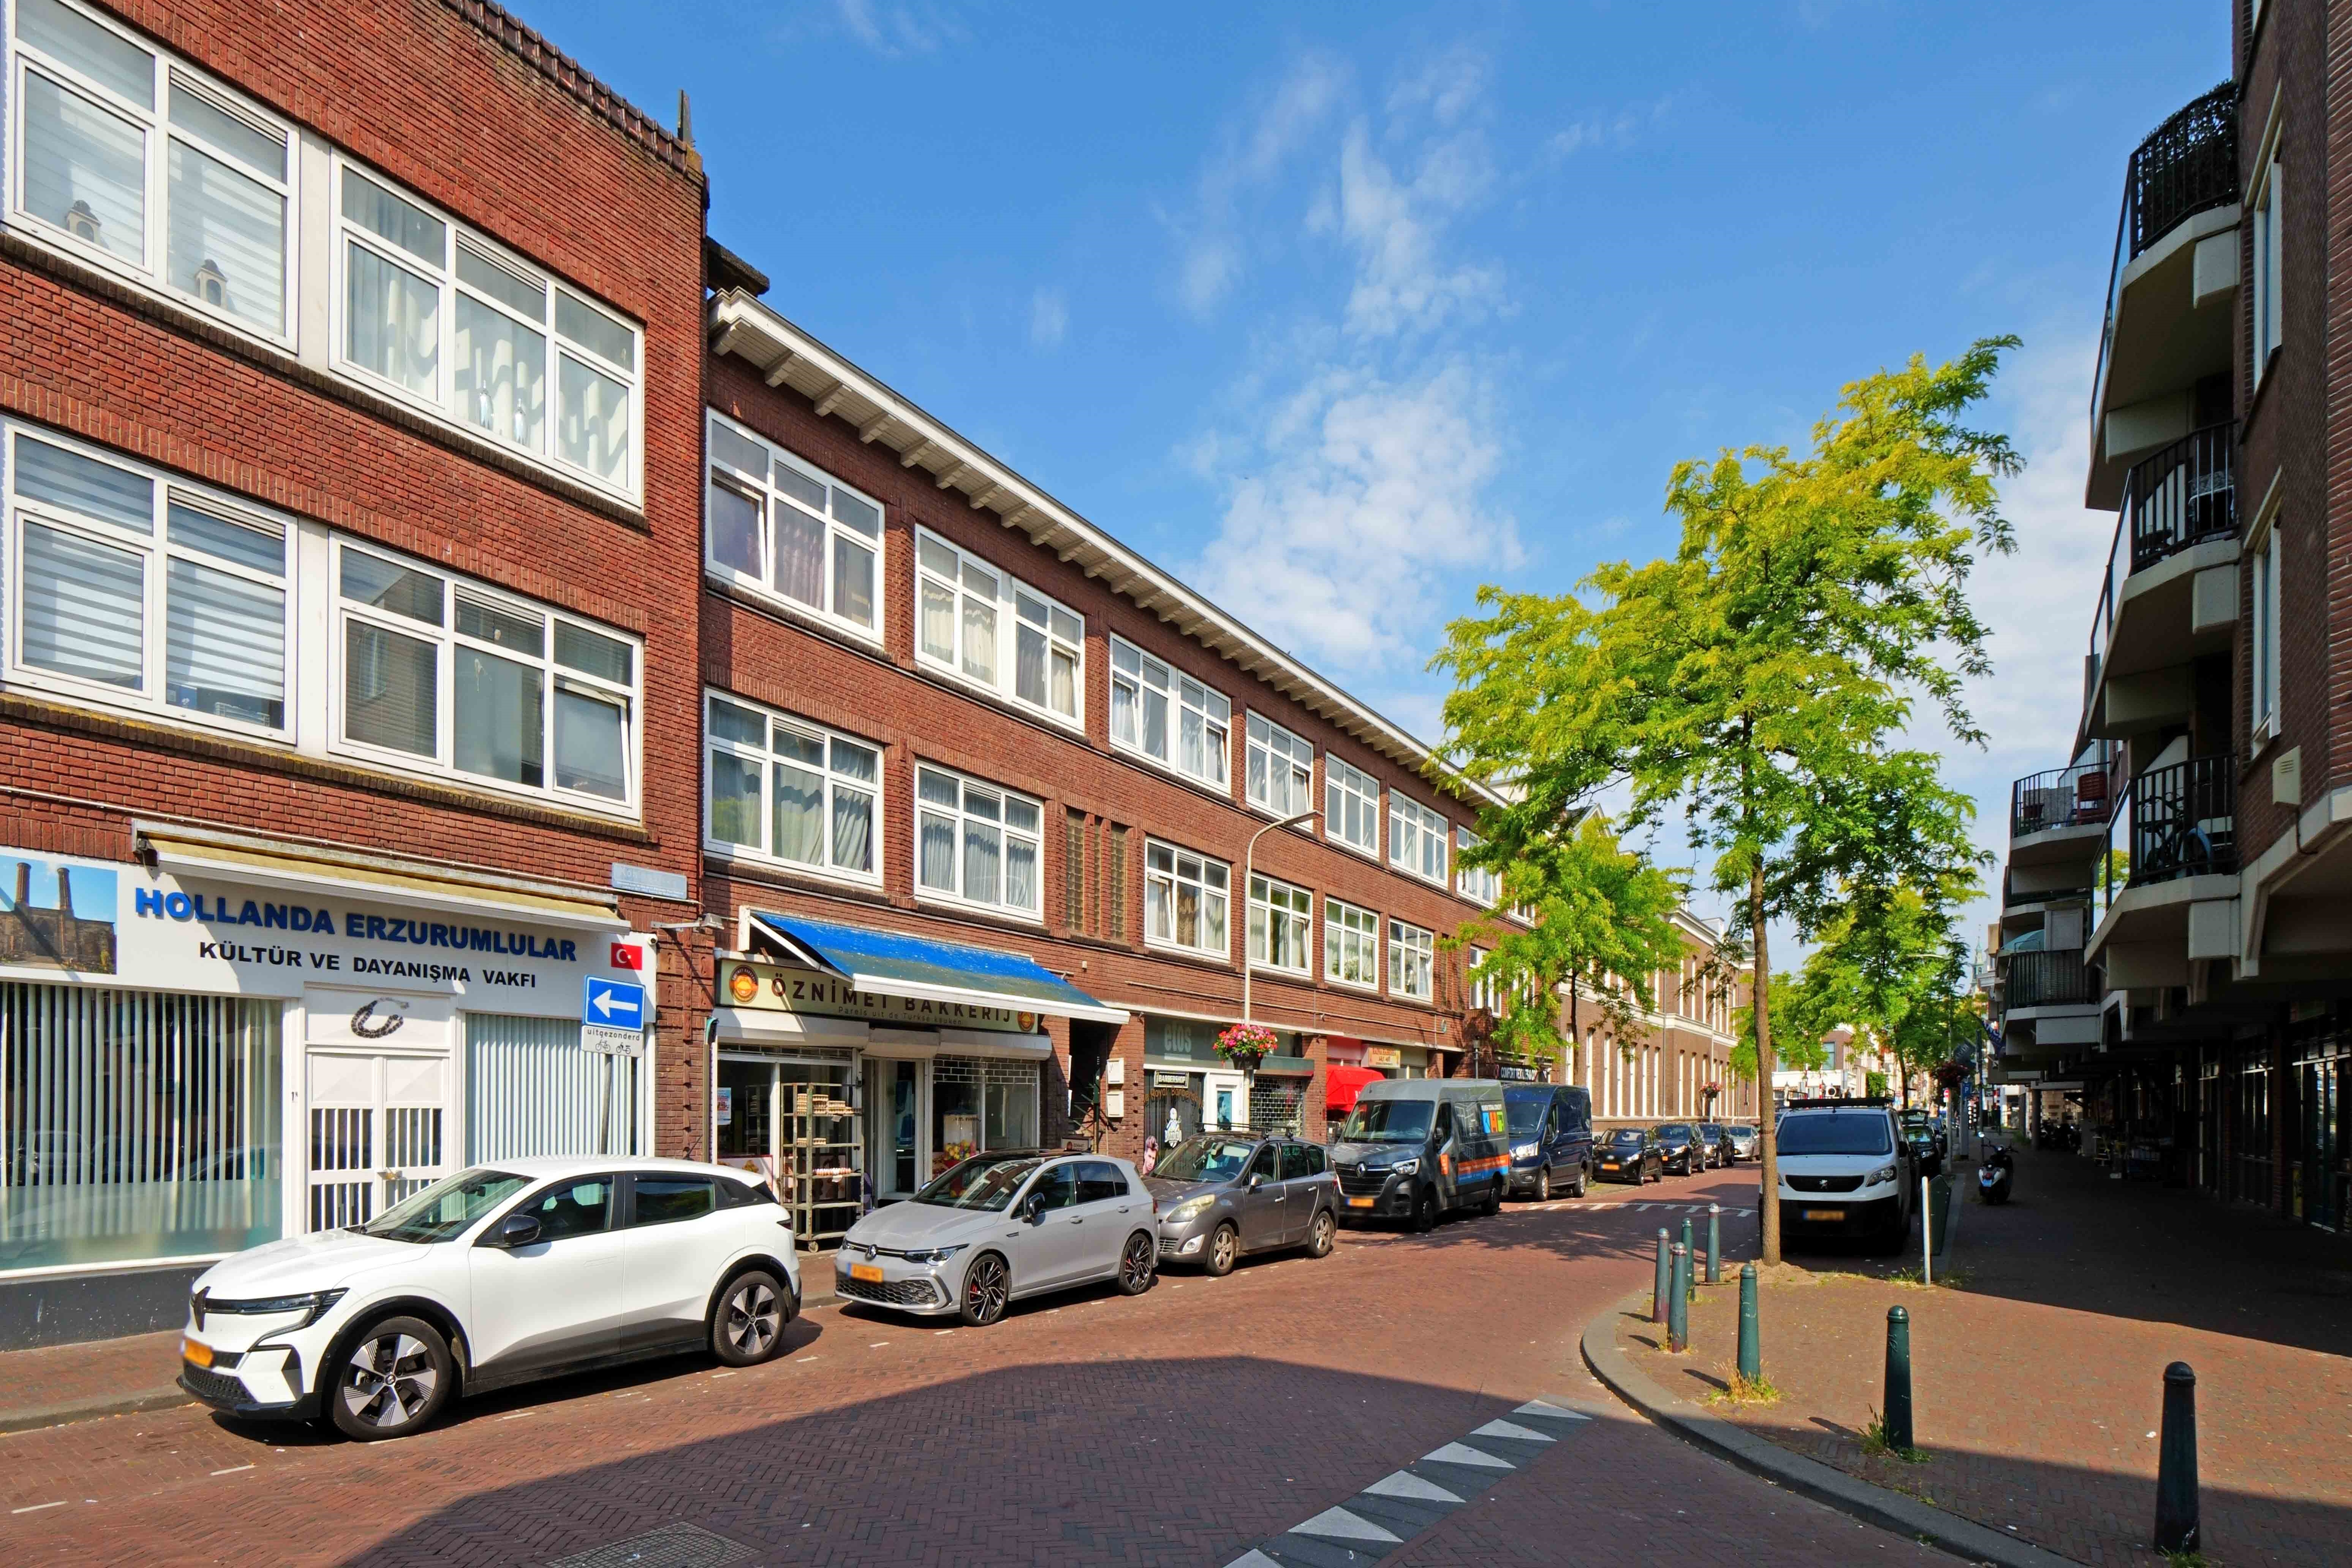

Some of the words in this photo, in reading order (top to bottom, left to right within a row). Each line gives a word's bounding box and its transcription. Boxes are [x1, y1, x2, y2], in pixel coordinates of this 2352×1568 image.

[135, 887, 335, 934] HOLLANDA
[346, 913, 576, 961] ERZURUMLULAR
[201, 940, 302, 967] KÜLTÜR
[310, 953, 340, 970] VE
[354, 957, 471, 983] DAYANIŞMA
[482, 969, 536, 988] VAKFI
[838, 1006, 868, 1015] Parels
[903, 1012, 931, 1022] Turkse
[905, 997, 1011, 1023] BAKKERIJ
[587, 1027, 640, 1041] uitgezonderd
[1164, 1024, 1192, 1053] etos
[1159, 1075, 1185, 1083] BARBERSHOP
[1501, 1066, 1516, 1079] COMFORT
[1150, 1087, 1168, 1100] Royal
